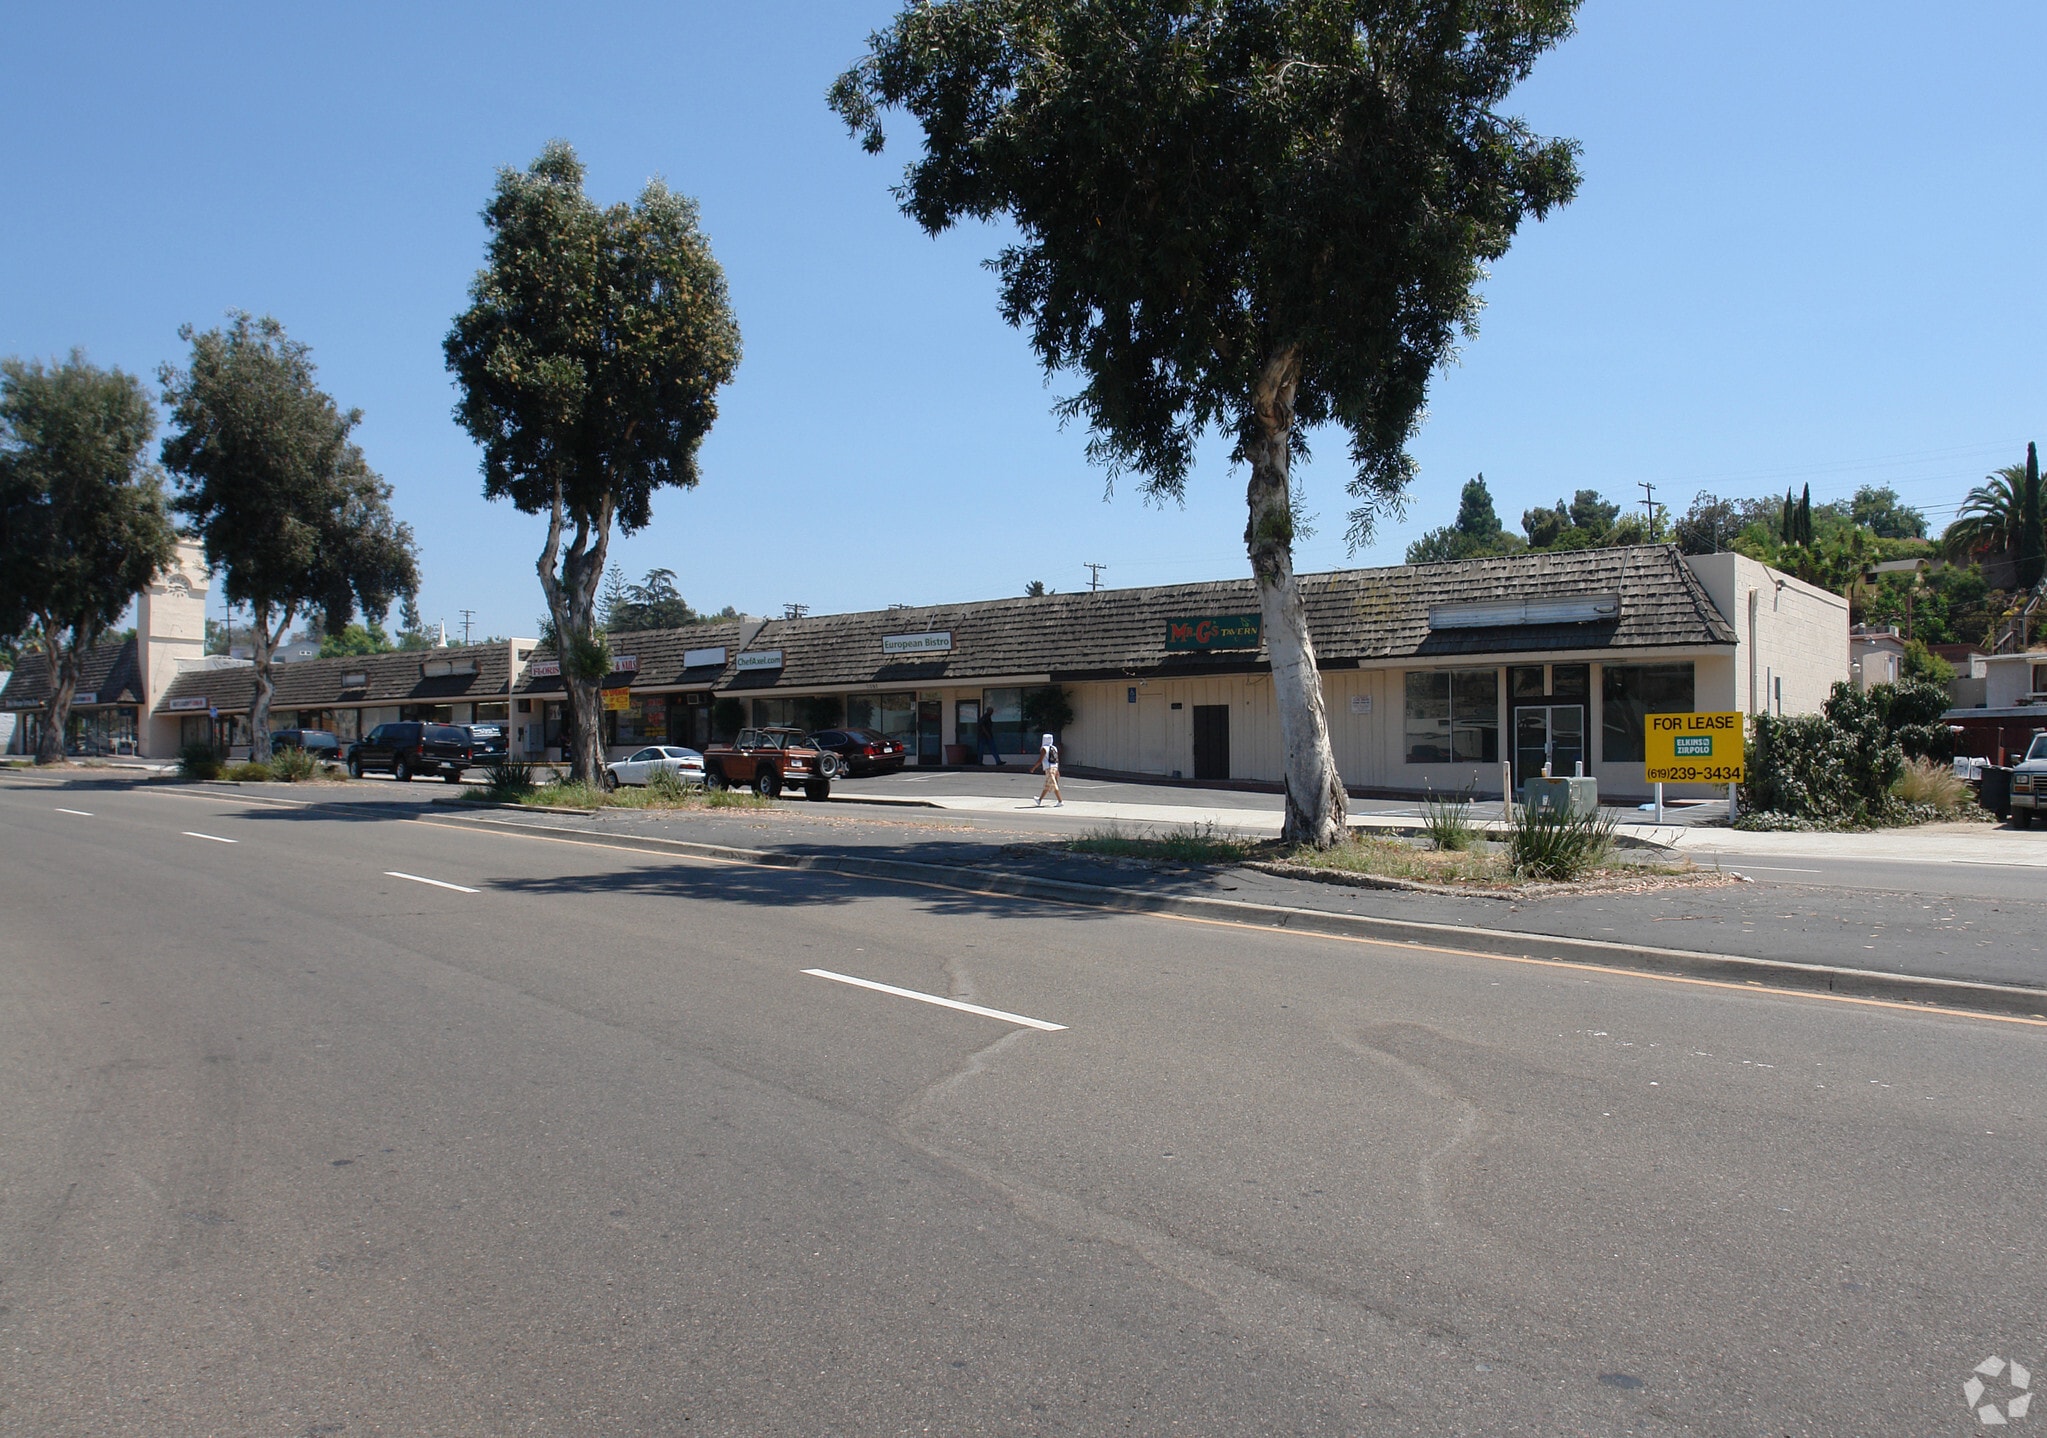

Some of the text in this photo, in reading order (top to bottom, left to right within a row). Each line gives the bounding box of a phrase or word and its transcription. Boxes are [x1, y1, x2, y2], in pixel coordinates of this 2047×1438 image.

[1221, 627, 1257, 636] TAVERN
[884, 637, 949, 650] European Bistro
[738, 656, 780, 665] ChefAxel.com
[1654, 716, 1734, 730] FOR LEASE
[1677, 746, 1709, 754] ZIRPOLO
